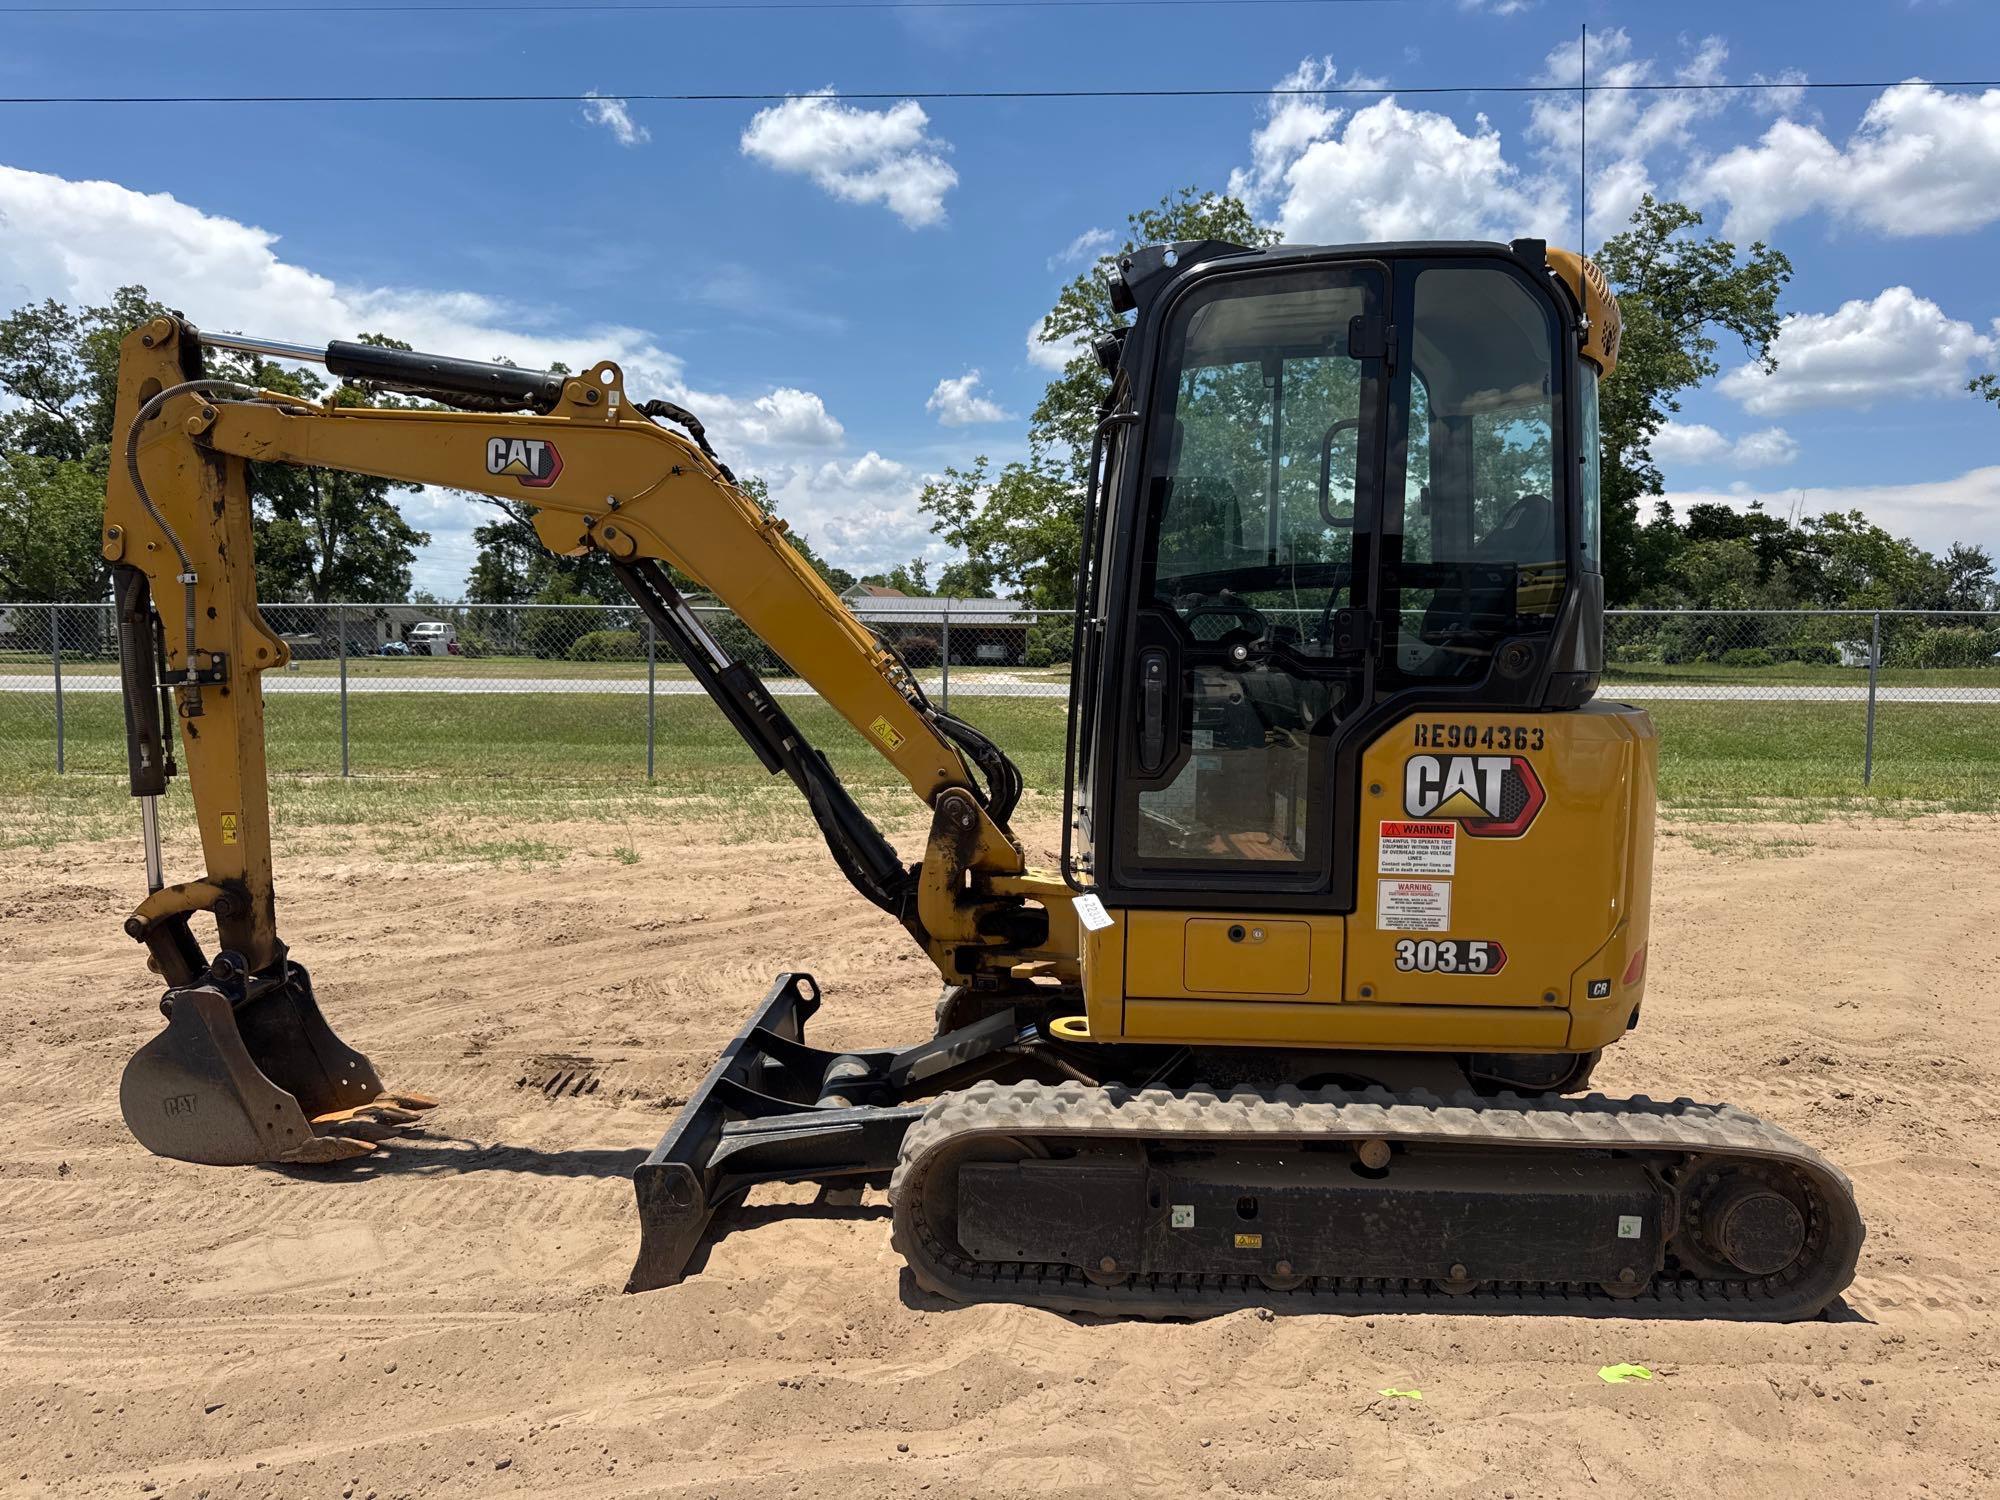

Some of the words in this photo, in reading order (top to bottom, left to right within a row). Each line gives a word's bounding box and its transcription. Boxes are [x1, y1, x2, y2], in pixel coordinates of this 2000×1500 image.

[487, 438, 545, 476] CAT
[1414, 724, 1545, 751] RE904363
[1405, 755, 1512, 818] CAT
[1403, 825, 1450, 835] WARNING
[1398, 883, 1432, 891] WARNING
[1396, 939, 1488, 973] 303.5
[1593, 982, 1608, 996] CR
[164, 1095, 197, 1120] CAT
